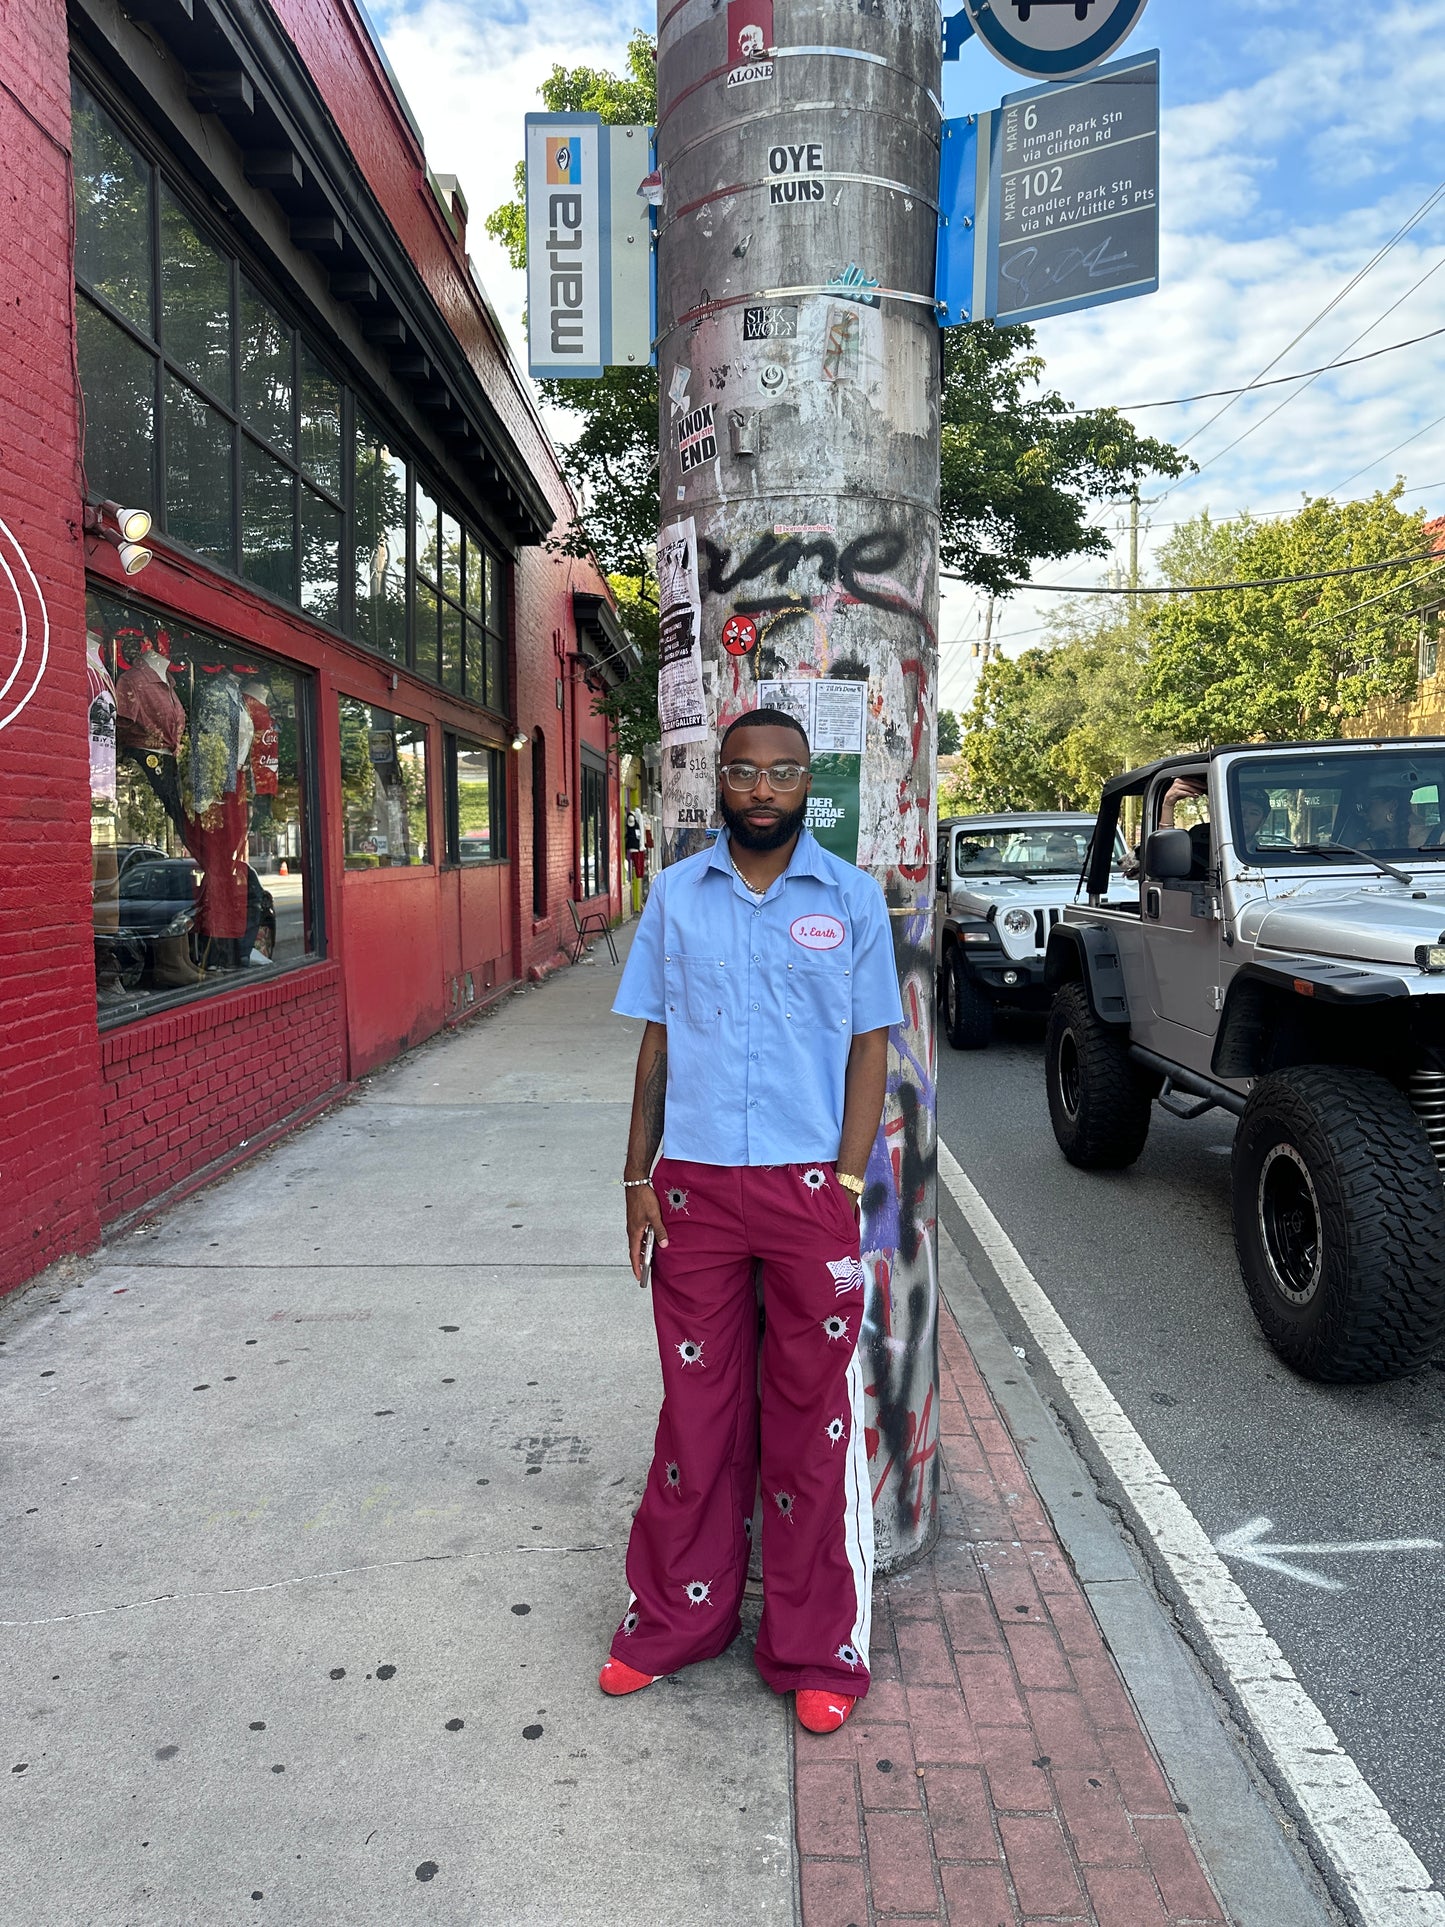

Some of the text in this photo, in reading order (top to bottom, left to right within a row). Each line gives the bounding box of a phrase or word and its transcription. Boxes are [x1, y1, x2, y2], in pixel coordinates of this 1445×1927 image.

[728, 64, 774, 85] ALONE
[1006, 108, 1019, 152] MARTA
[1023, 111, 1123, 148] Inman Park Stn
[1024, 105, 1037, 130] 6
[769, 144, 823, 174] OYE
[1023, 128, 1111, 162] via Clifton Rd
[1022, 166, 1063, 199] 102
[1004, 177, 1016, 221] MARTA
[1021, 189, 1154, 232] via N Av/Little 5 Pts
[1022, 180, 1132, 217] Candler Park Stn
[546, 194, 583, 353] marta
[747, 306, 785, 324] SILK
[678, 404, 713, 443] KNOX
[701, 426, 714, 437] STEP
[681, 435, 717, 473] END
[675, 715, 701, 728] GALLERY
[689, 757, 707, 773] $16
[678, 808, 708, 823] EAR
[815, 817, 837, 828] DO?
[810, 927, 837, 939] Earth
